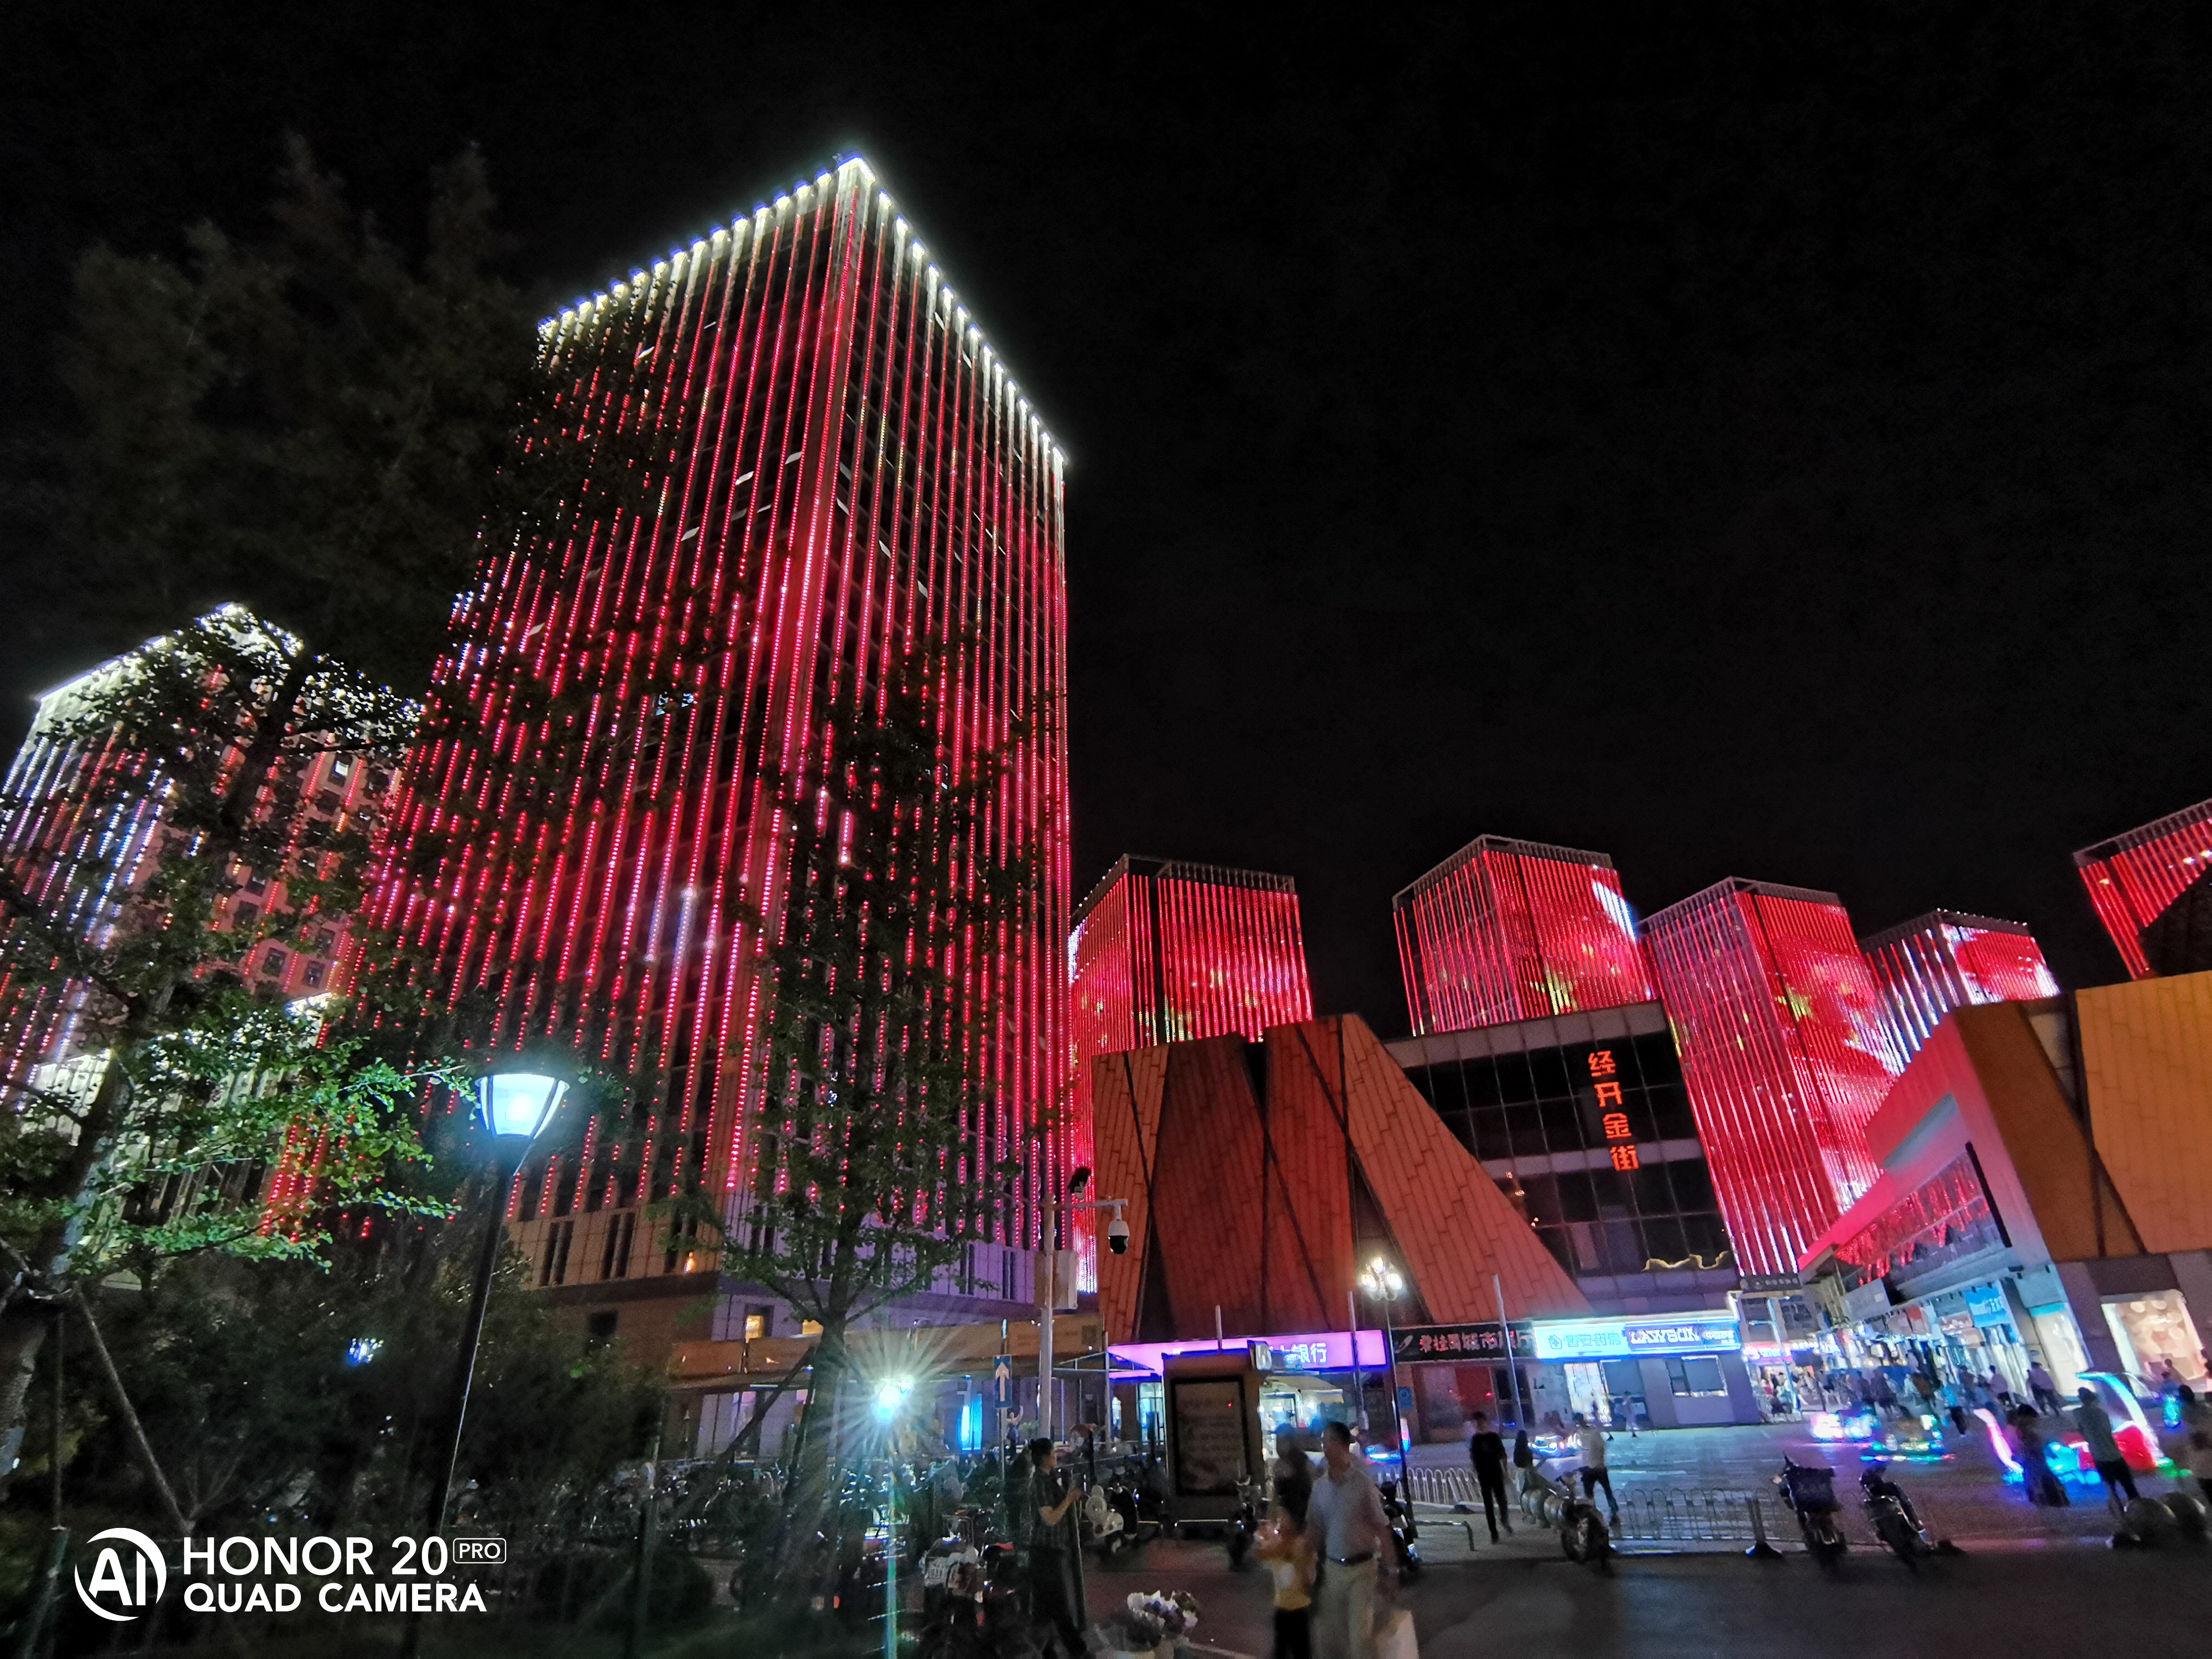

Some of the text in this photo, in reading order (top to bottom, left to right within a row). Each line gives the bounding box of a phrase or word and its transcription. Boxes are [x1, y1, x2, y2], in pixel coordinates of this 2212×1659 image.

[1588, 1050, 1639, 1171] 经开金街
[1629, 1327, 1701, 1344] LAWSON
